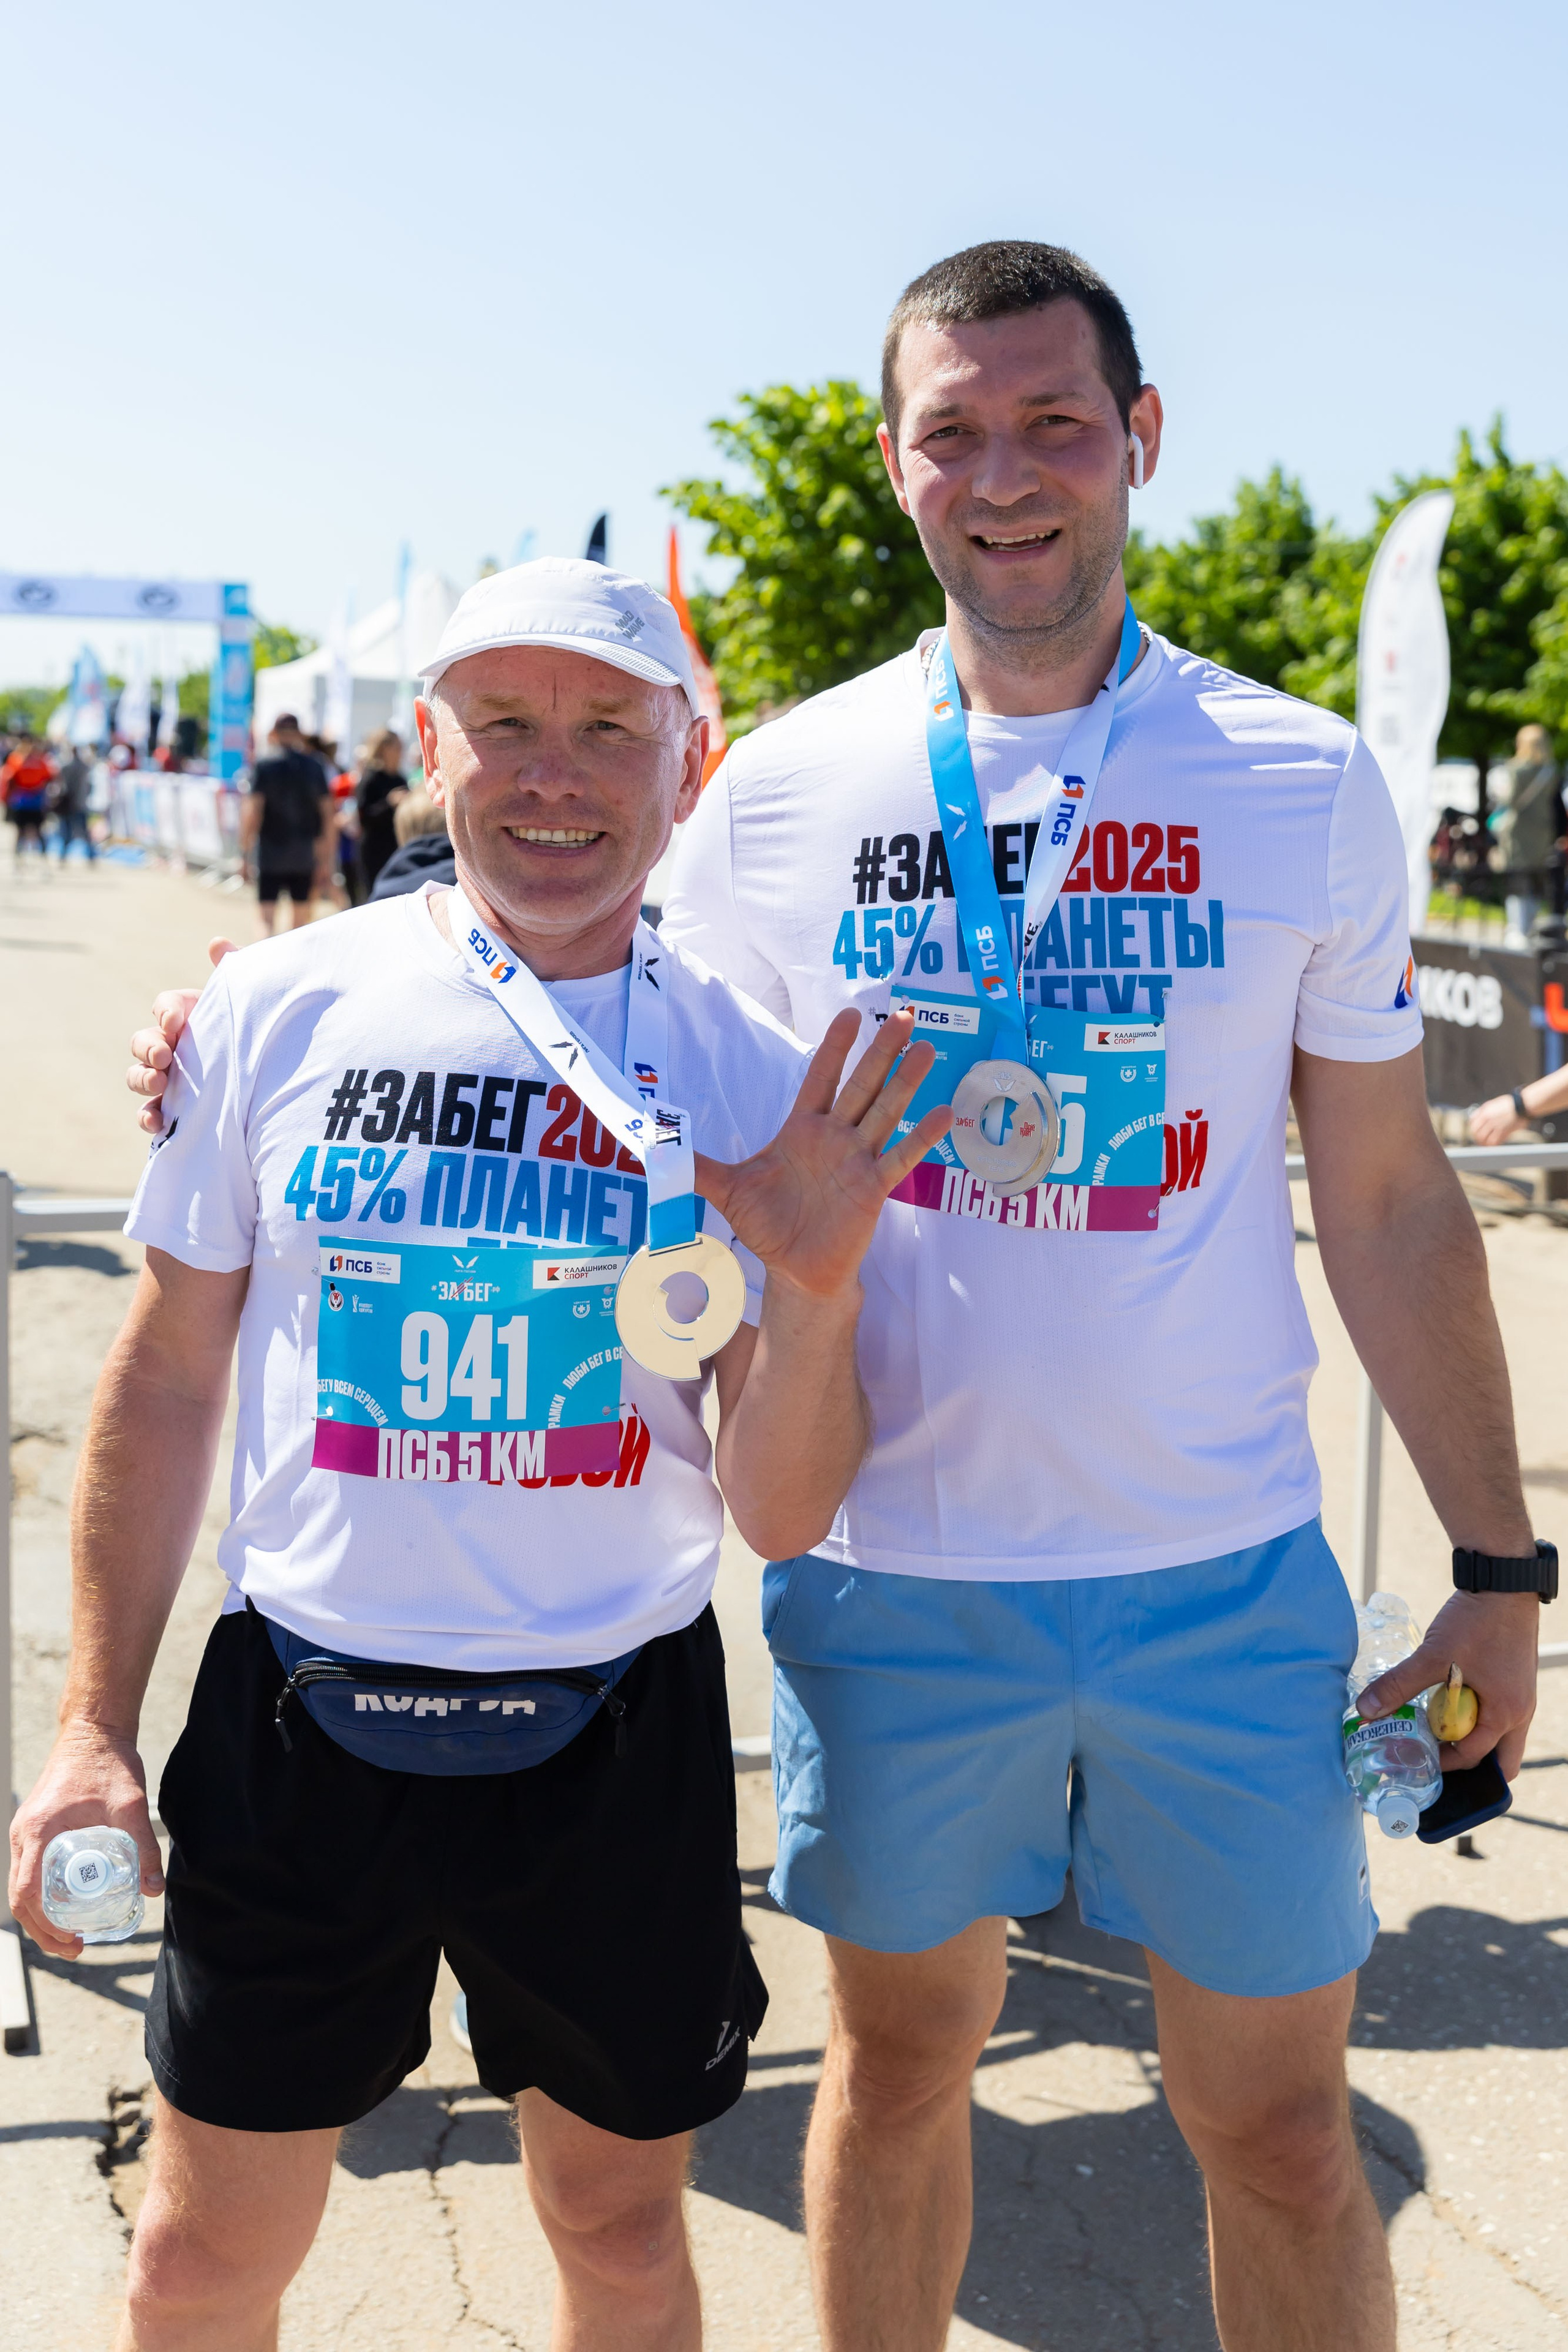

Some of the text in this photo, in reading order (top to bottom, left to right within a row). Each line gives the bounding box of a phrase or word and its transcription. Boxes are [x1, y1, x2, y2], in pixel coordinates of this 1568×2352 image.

[615, 610, 635, 631] MAD
[622, 617, 645, 639] WAVE
[1050, 803, 1076, 846] ПСБ
[468, 929, 497, 967] ПСБ
[832, 905, 943, 980] 45%
[976, 925, 999, 971] ПСБ
[918, 1009, 949, 1024] ПСБ
[1092, 1153, 1111, 1185] РАМКИ
[1108, 1125, 1134, 1150] ЛЮБИ
[1133, 1116, 1148, 1133] БЕГ
[1148, 1114, 1155, 1126] В
[284, 1145, 408, 1224] 45%
[940, 1166, 1003, 1223] ПСБ
[1035, 1183, 1090, 1231] КМ
[346, 1259, 372, 1273] ПСБ
[564, 1264, 617, 1273] КАЛАШНИКОВ
[401, 1311, 529, 1420] 941
[334, 1379, 355, 1397] ВСЕМ
[353, 1387, 389, 1427] СЕРДЦЕМ
[548, 1393, 566, 1429] РАМКИ
[562, 1361, 590, 1390] ЛЮБИ
[587, 1352, 603, 1370] БЕГ
[605, 1349, 612, 1362] В
[377, 1428, 450, 1482] ПСБ
[458, 1432, 481, 1482] 5
[489, 1430, 546, 1481] КМ
[1347, 1720, 1412, 1750] СЕНЕЖСКАЯ
[706, 2026, 740, 2070] DEMIX
